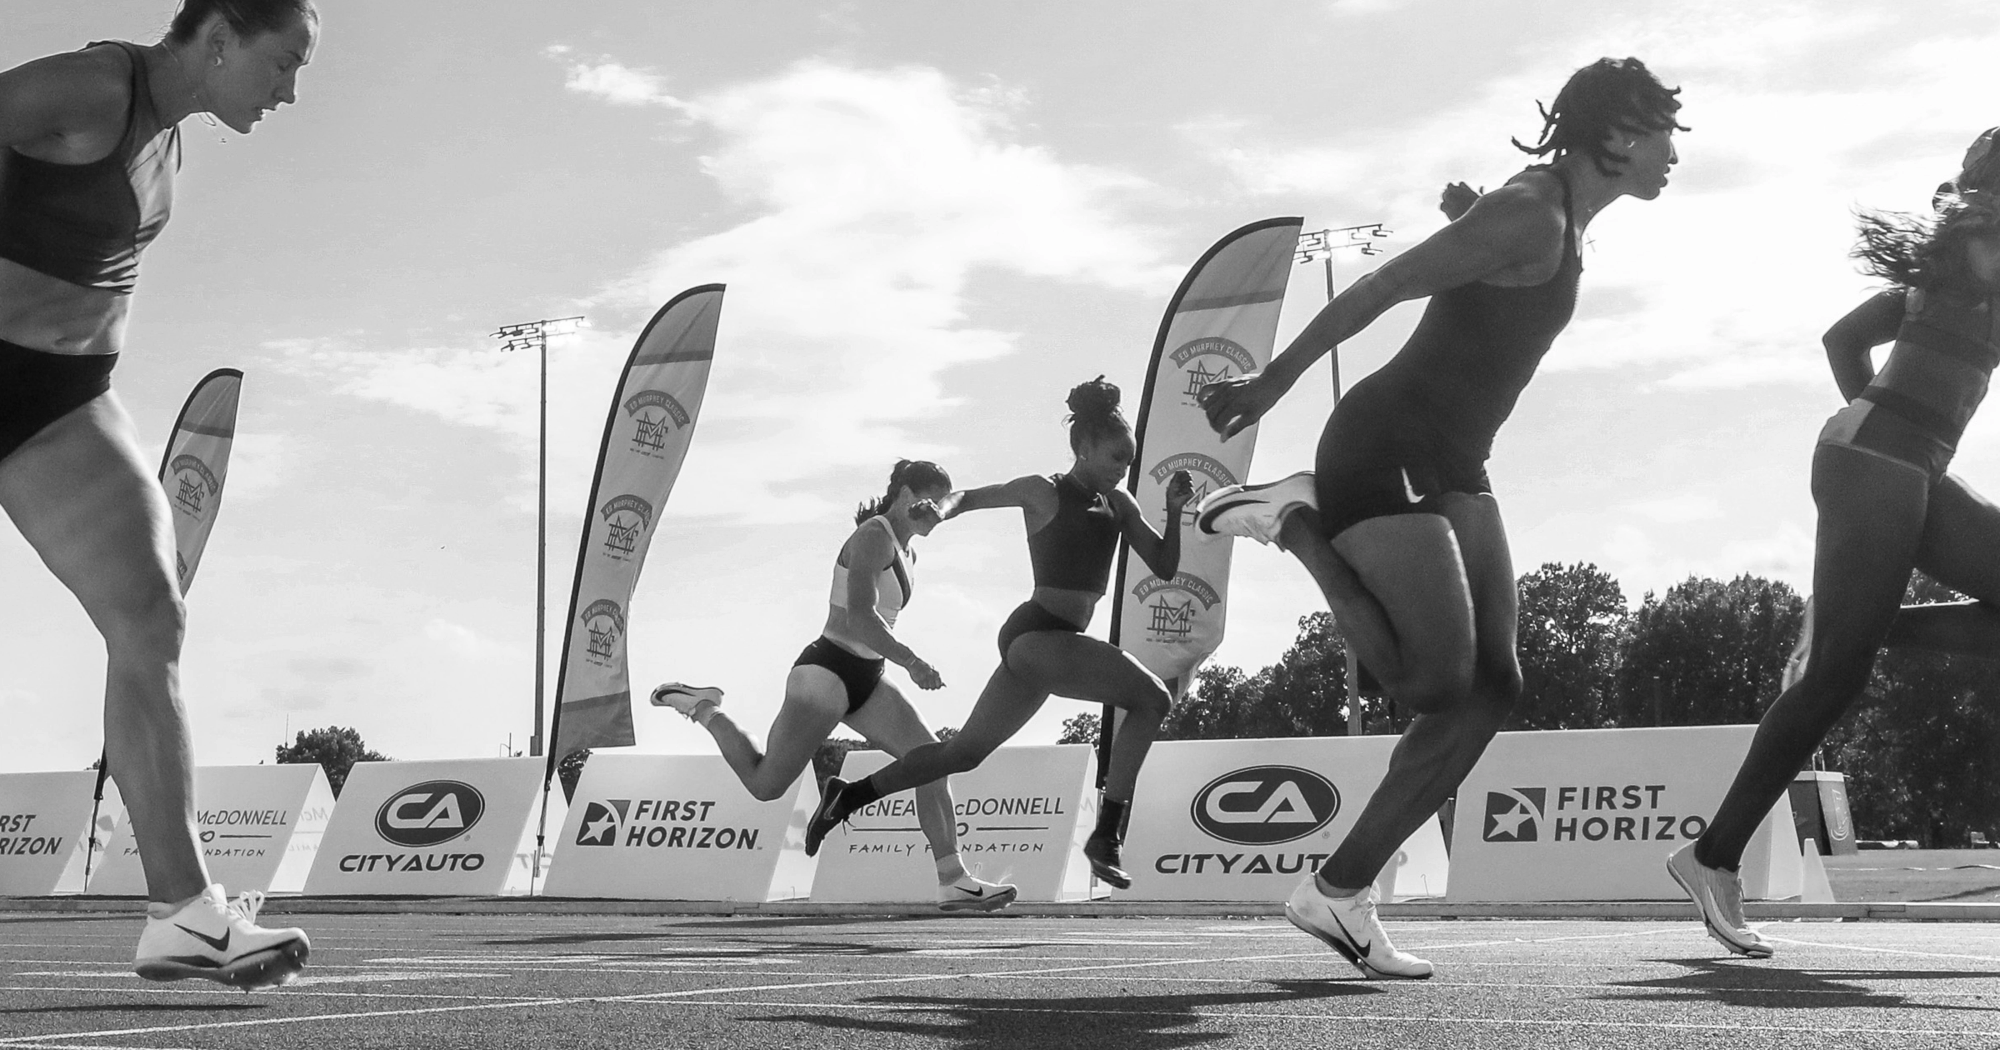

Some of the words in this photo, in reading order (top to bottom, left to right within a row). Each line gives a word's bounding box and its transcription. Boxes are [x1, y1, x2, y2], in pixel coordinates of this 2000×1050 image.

[1178, 350, 1189, 361] ED
[1189, 342, 1226, 355] MURPHEY
[1225, 346, 1252, 371] CLASSIC
[1157, 466, 1168, 477] ED
[1167, 458, 1203, 471] MURPHEY
[1203, 461, 1232, 488] CLASSIC
[1139, 584, 1149, 596] ED
[1187, 580, 1214, 604] CLASSIC
[955, 797, 1065, 816] cDONNELL
[1557, 785, 1666, 811] FIRST
[634, 800, 716, 822] FIRST
[0, 814, 37, 832] RST
[1554, 815, 1708, 842] HORIZO
[0, 837, 63, 855] RIZON
[625, 826, 760, 850] HORIZON
[203, 848, 266, 857] NDATION
[848, 843, 916, 857] FAMILY
[924, 843, 1044, 853] FNDATION
[1155, 853, 1332, 874] CITYAUT
